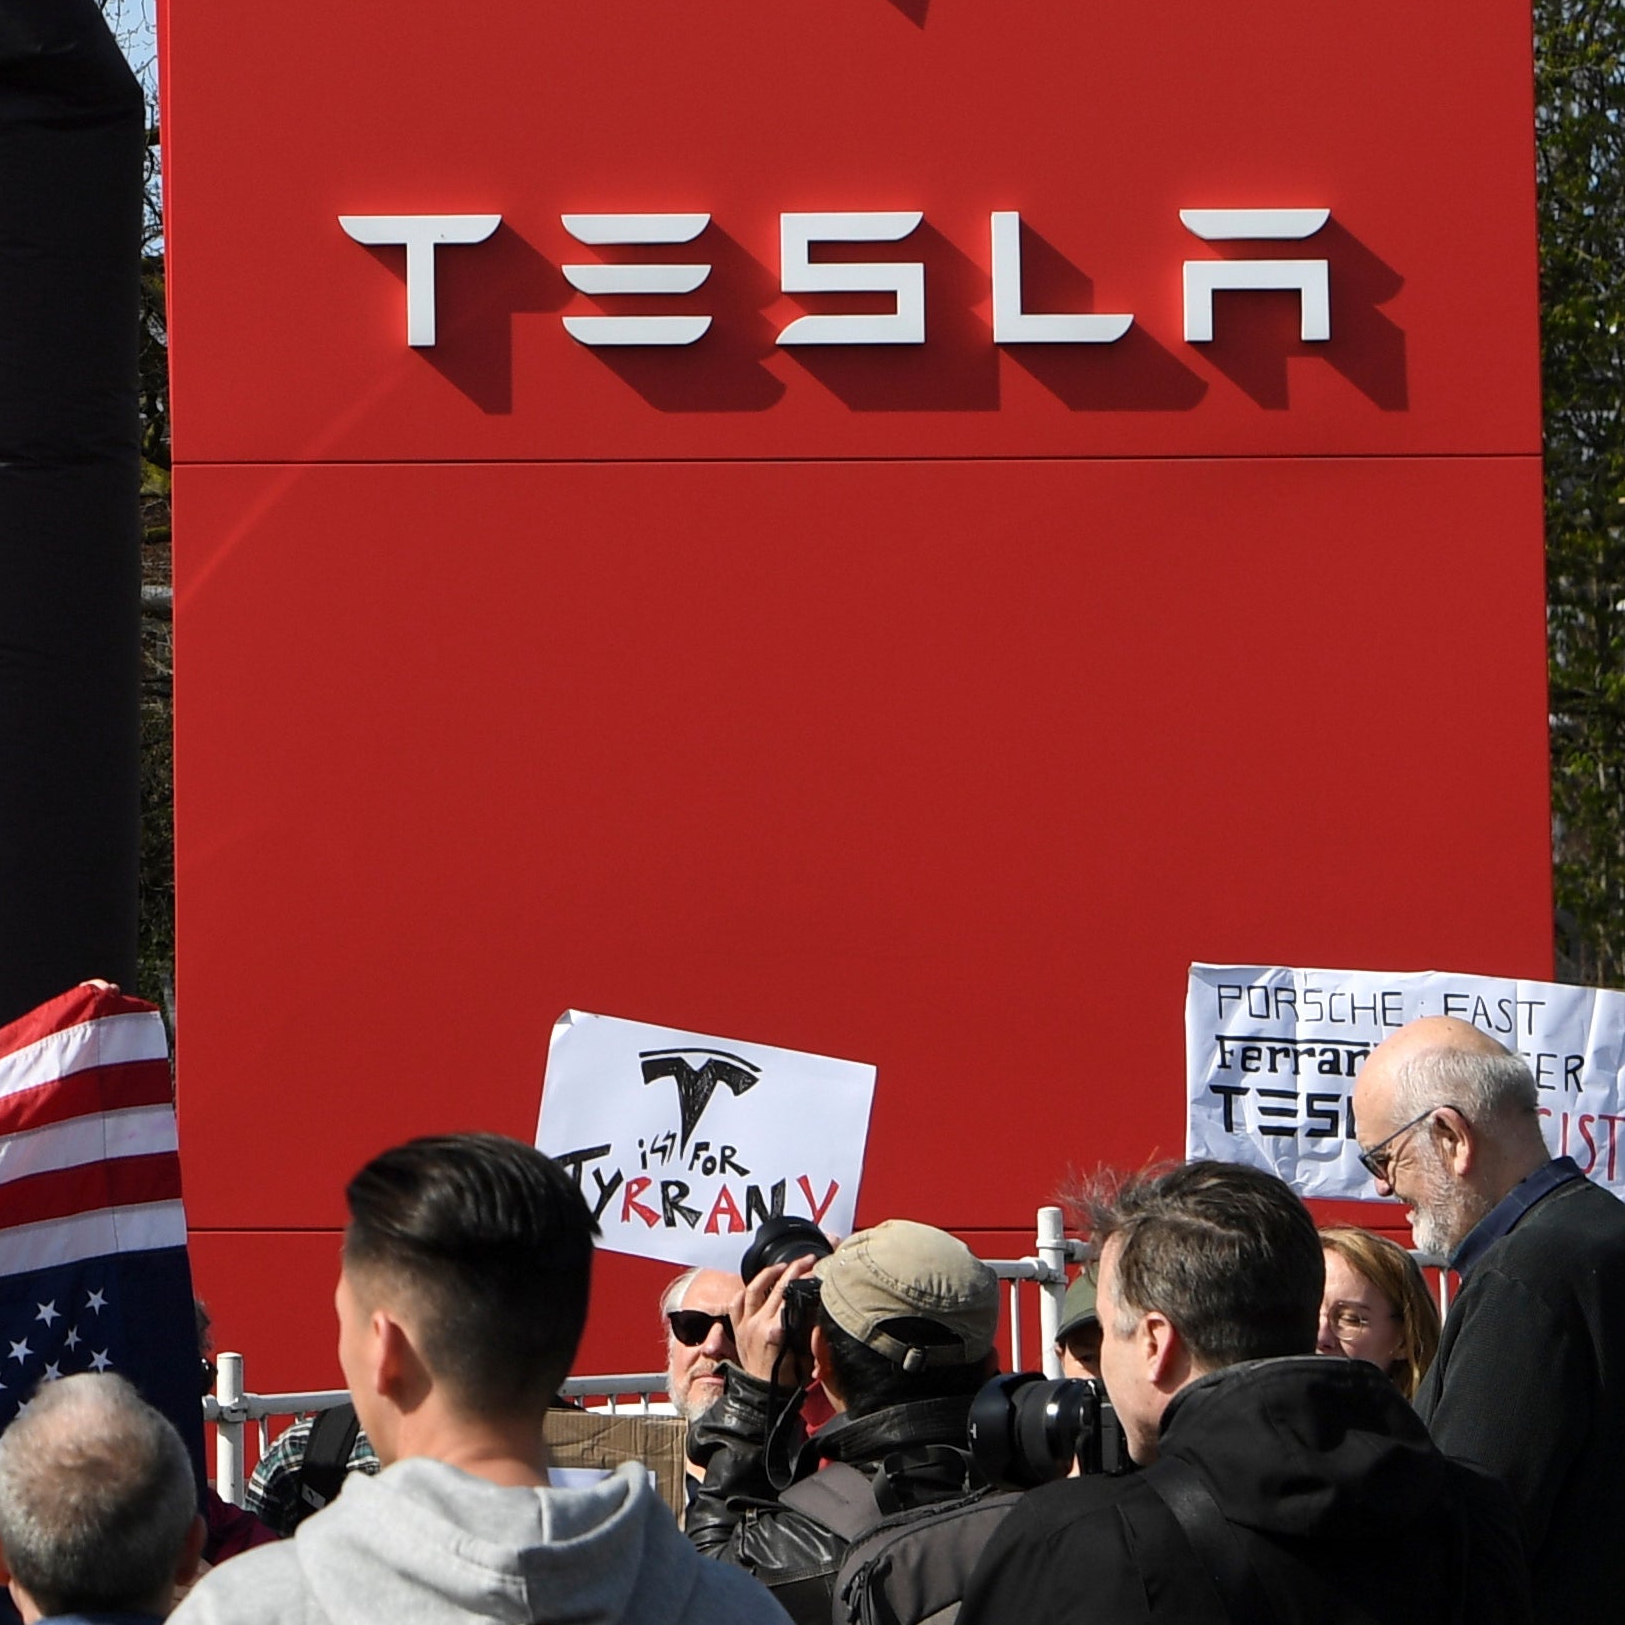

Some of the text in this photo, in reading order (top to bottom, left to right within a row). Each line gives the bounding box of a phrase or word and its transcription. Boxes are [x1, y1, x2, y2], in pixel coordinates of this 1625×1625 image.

[338, 208, 1331, 347] TESLA
[1443, 993, 1546, 1035] FAST
[1215, 1034, 1585, 1093] Ferrar ER
[688, 1141, 751, 1177] FOR
[1538, 1108, 1625, 1182] IST
[553, 1144, 840, 1236] TYRRANY
